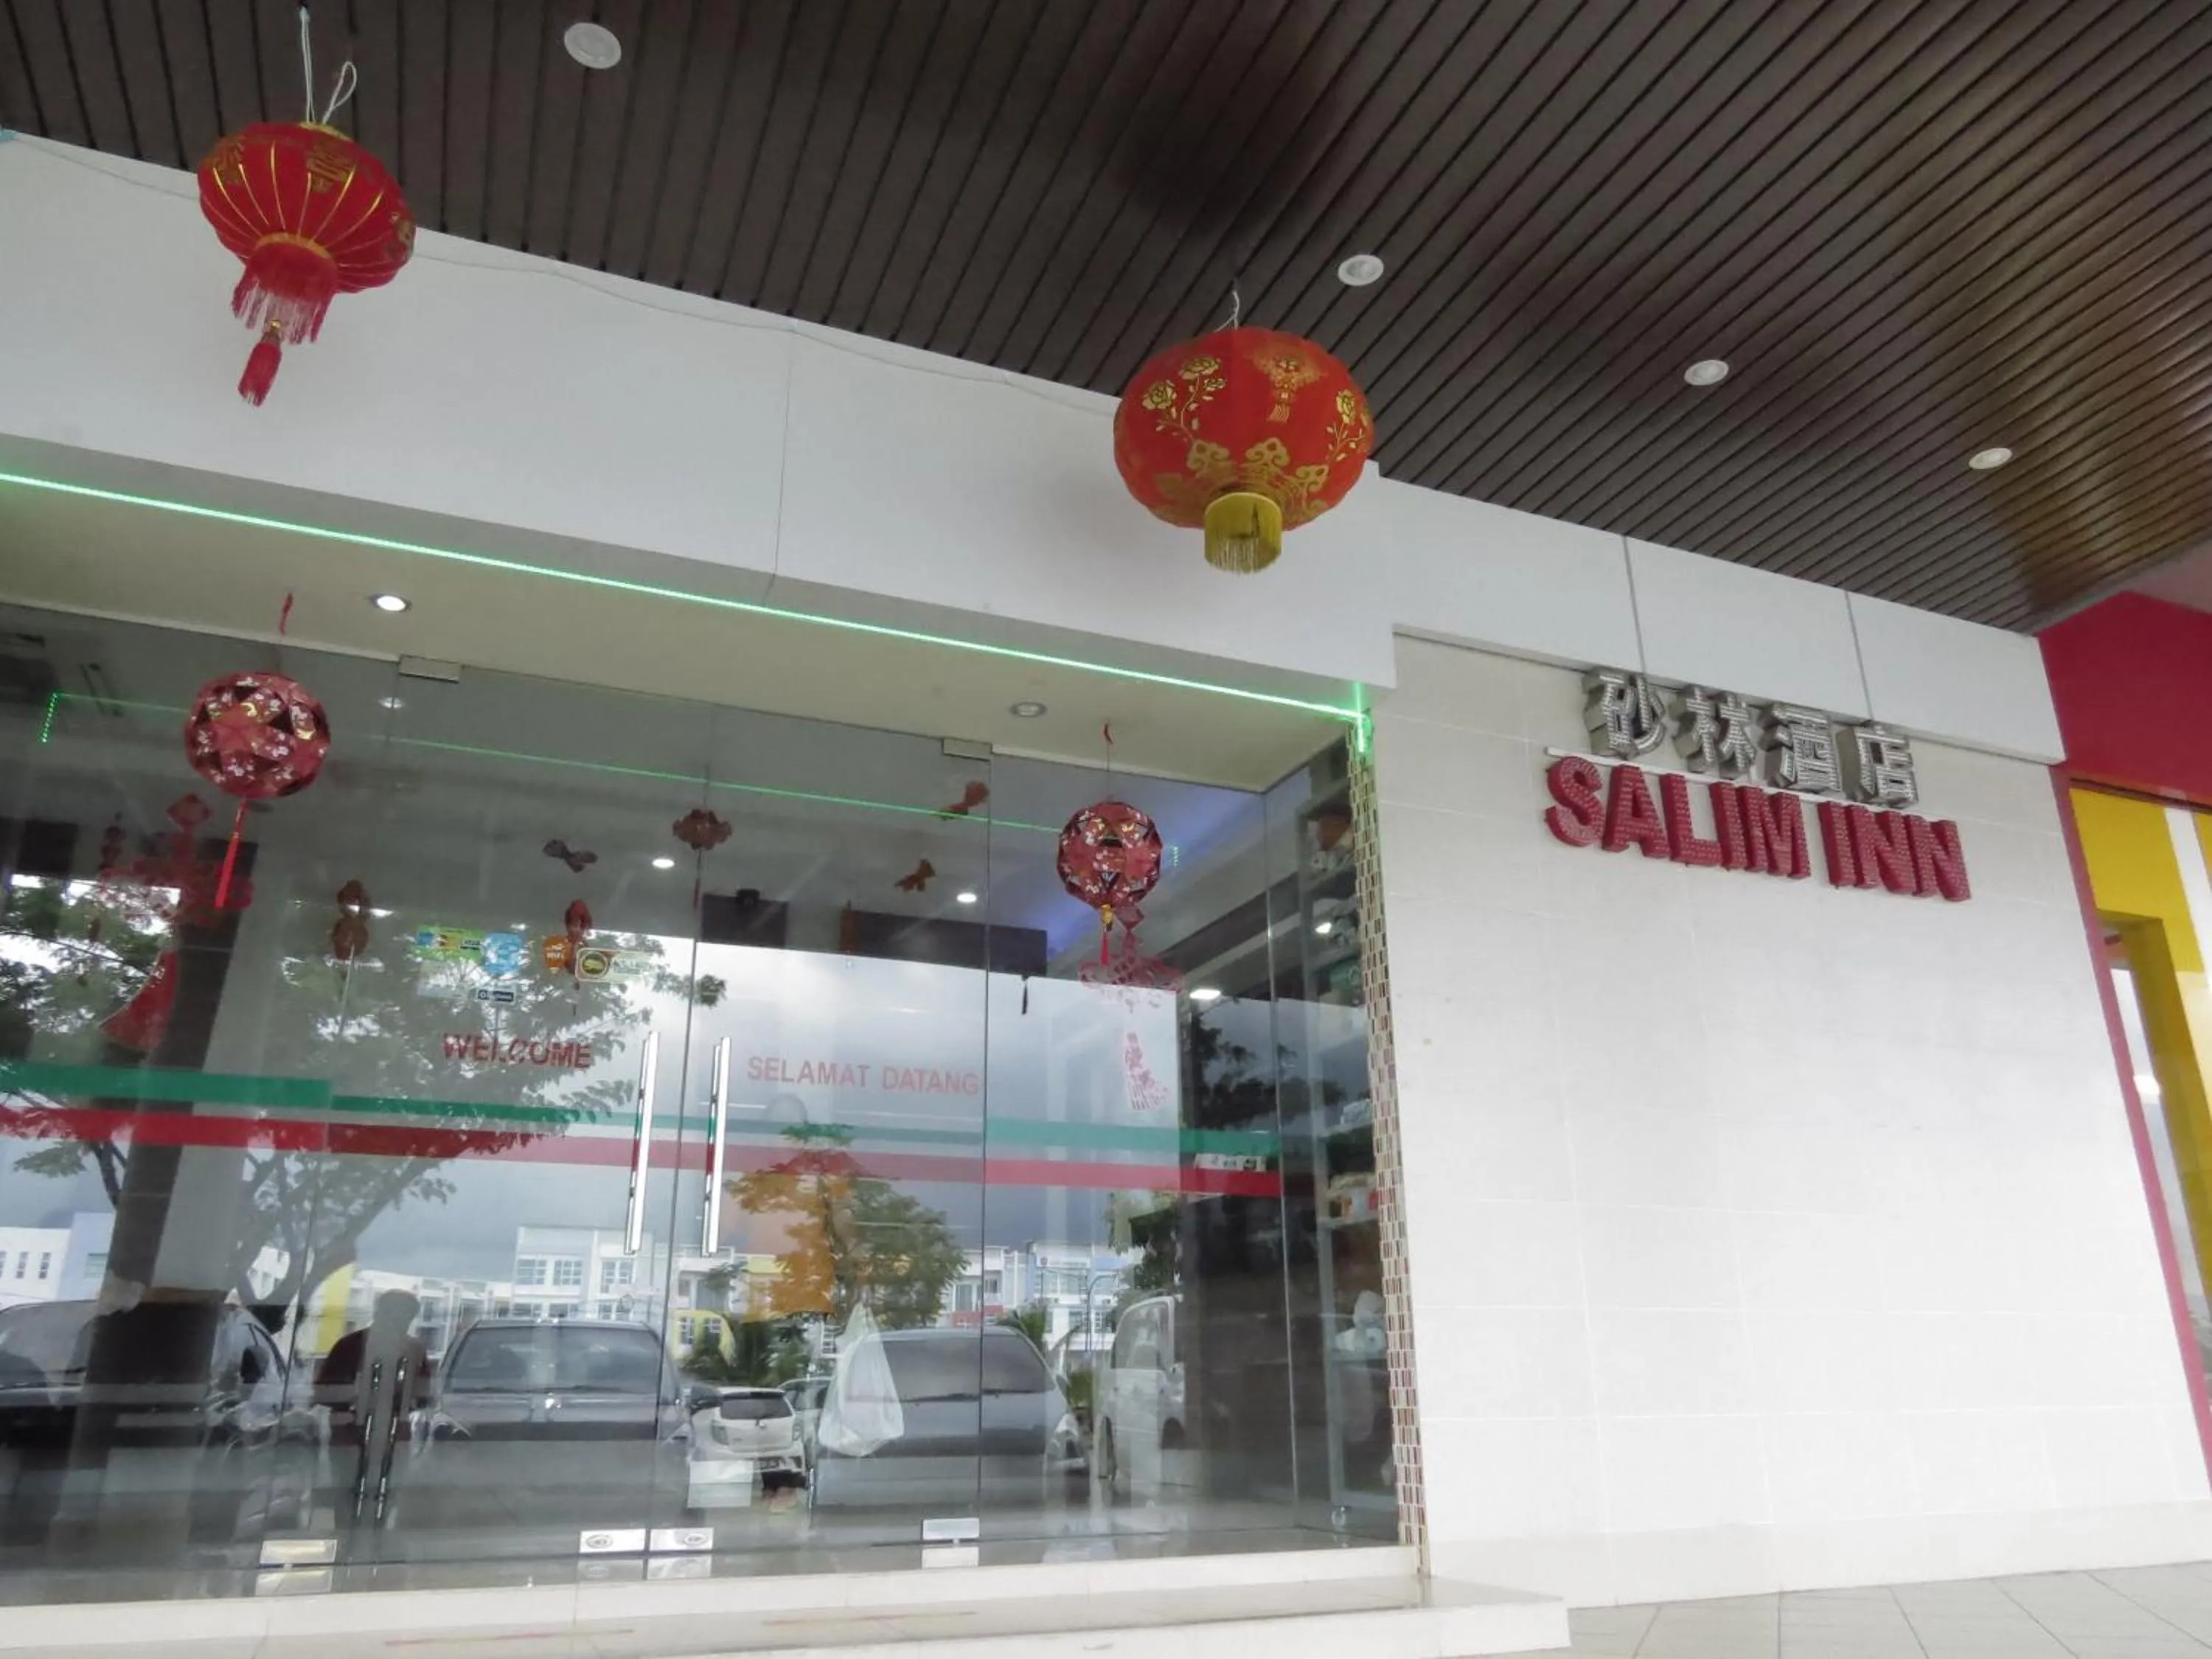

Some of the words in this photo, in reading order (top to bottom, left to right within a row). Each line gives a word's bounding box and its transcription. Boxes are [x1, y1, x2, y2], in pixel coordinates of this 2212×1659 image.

[1544, 755, 1811, 878] SALIM
[1817, 799, 1972, 902] INN
[442, 1033, 592, 1069] WELCOME
[747, 1056, 870, 1088] SELAMAT
[881, 1065, 980, 1096] DATANG
